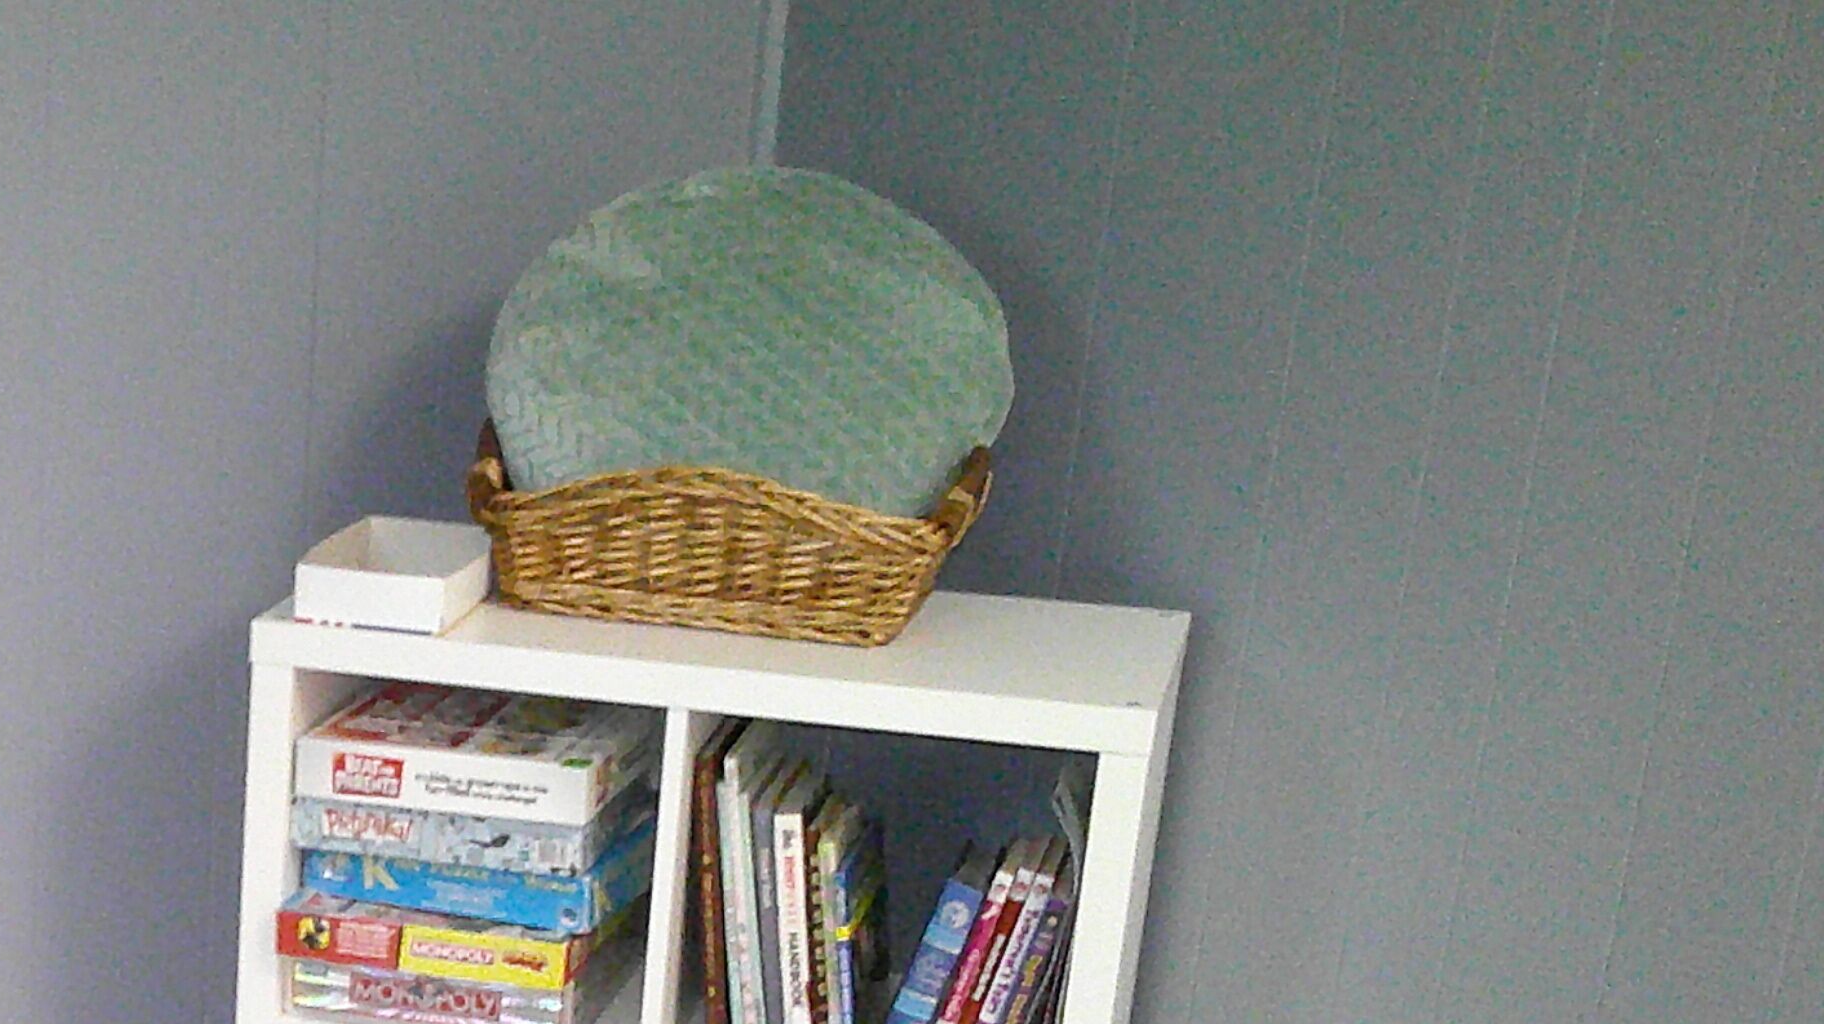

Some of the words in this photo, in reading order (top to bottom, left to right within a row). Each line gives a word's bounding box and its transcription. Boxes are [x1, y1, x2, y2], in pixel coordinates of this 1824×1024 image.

[411, 940, 493, 965] MONOPOLY
[788, 931, 805, 1008] HANDBOOK
[354, 977, 498, 1020] MONOPOLY
